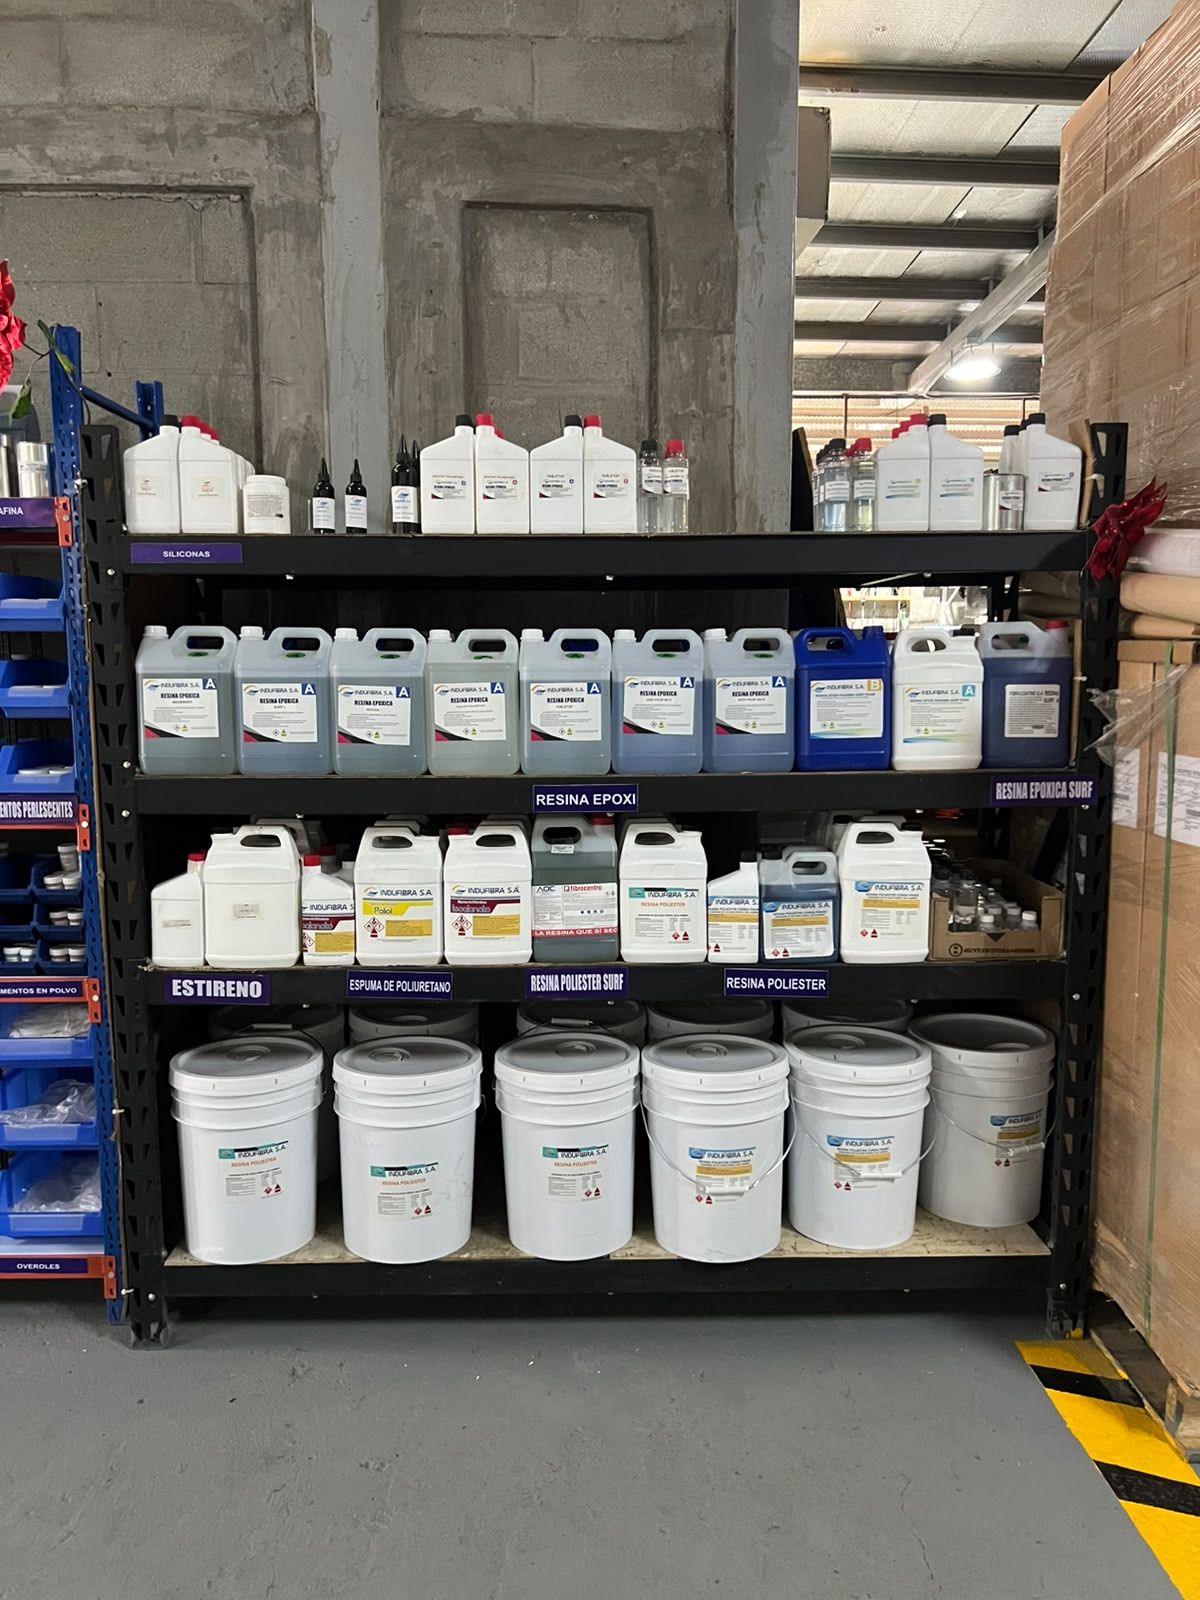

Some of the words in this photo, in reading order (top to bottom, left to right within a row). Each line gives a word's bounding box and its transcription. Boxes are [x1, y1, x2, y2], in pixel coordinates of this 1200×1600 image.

[0, 507, 24, 515] AFINA
[205, 678, 216, 688] A
[493, 682, 504, 692] A
[683, 677, 693, 687] A
[774, 677, 784, 687] A
[870, 680, 881, 690] B
[304, 684, 314, 694] A
[399, 686, 409, 697] A
[589, 682, 600, 693] A
[964, 685, 974, 696] A
[996, 782, 1028, 800] RESINA
[1030, 781, 1067, 799] EPOXICA
[1068, 780, 1093, 798] SURF
[536, 794, 589, 806] RESINA
[593, 793, 636, 805] EPOXI
[0, 801, 22, 818] ENTOS
[22, 801, 73, 818] PERLESCENTES
[374, 906, 392, 914] Poliol
[350, 979, 382, 991] ESPUMA
[384, 980, 394, 991] DE
[396, 980, 451, 992] POLIURETANO
[531, 974, 560, 992] RESINA
[561, 974, 602, 991] POLIESTER
[603, 973, 624, 991] SURF
[726, 977, 765, 989] RESINA
[768, 978, 826, 991] POLIESTER
[172, 979, 262, 998] ESTIRENO
[238, 1148, 273, 1158] INDUFIBRA
[388, 1169, 423, 1177] INDUFIBRA
